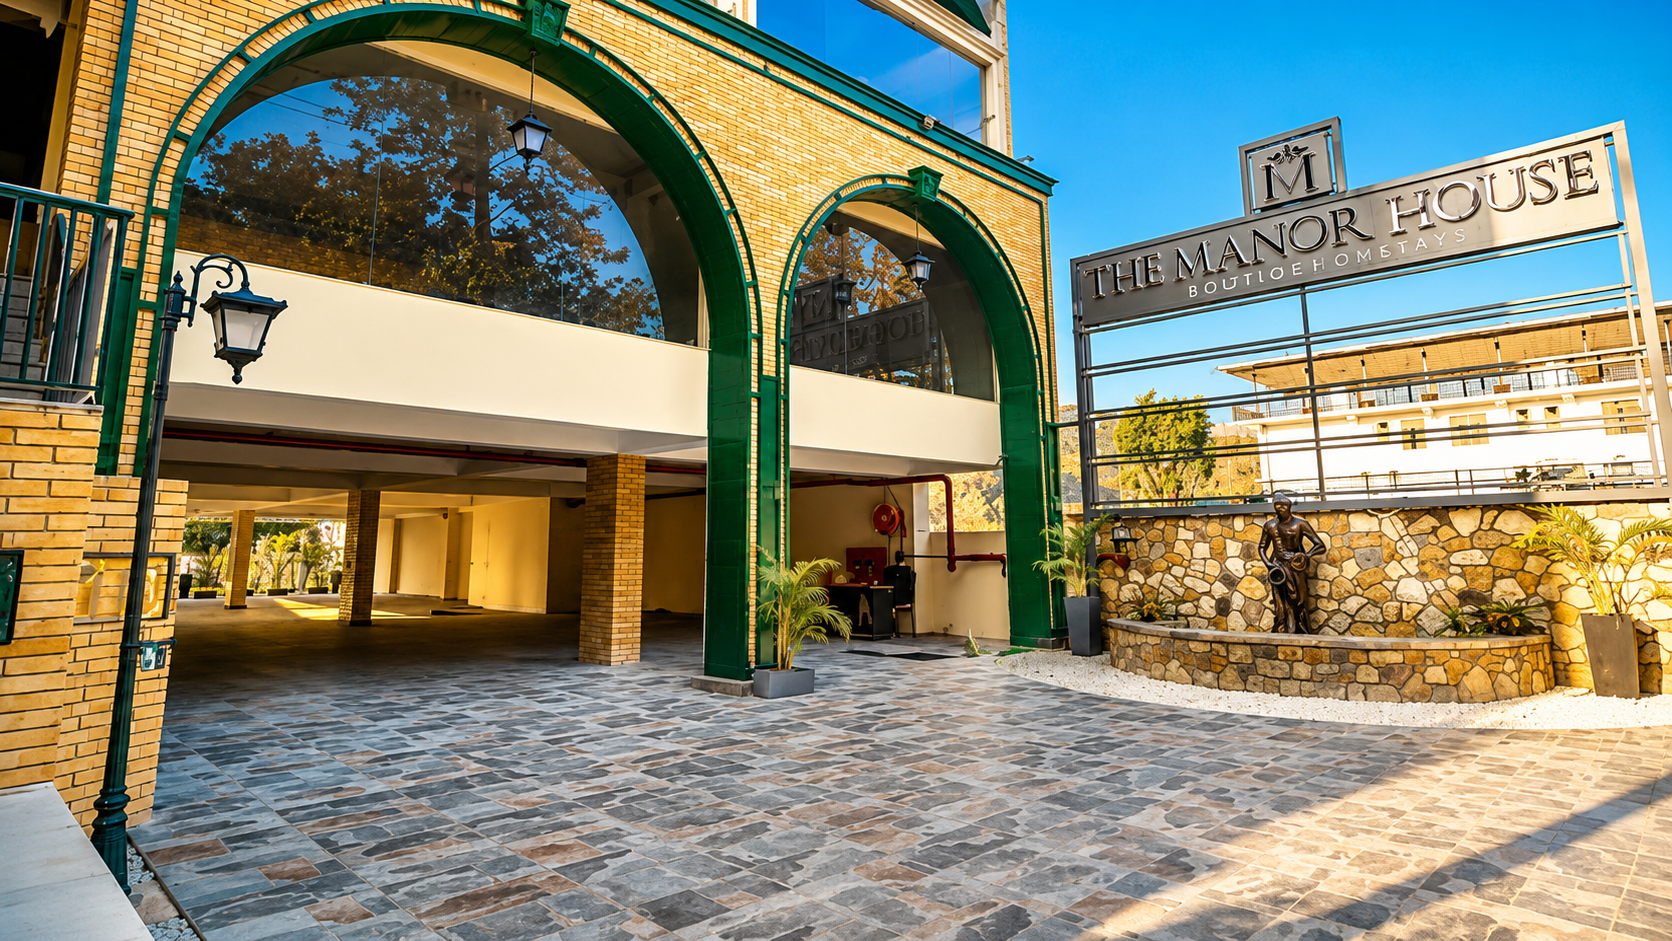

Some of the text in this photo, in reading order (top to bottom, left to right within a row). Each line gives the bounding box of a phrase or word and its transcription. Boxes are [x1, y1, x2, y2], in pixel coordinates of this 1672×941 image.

[1083, 150, 1600, 299] THE MANOR HOUSE
[1260, 151, 1319, 203] M
